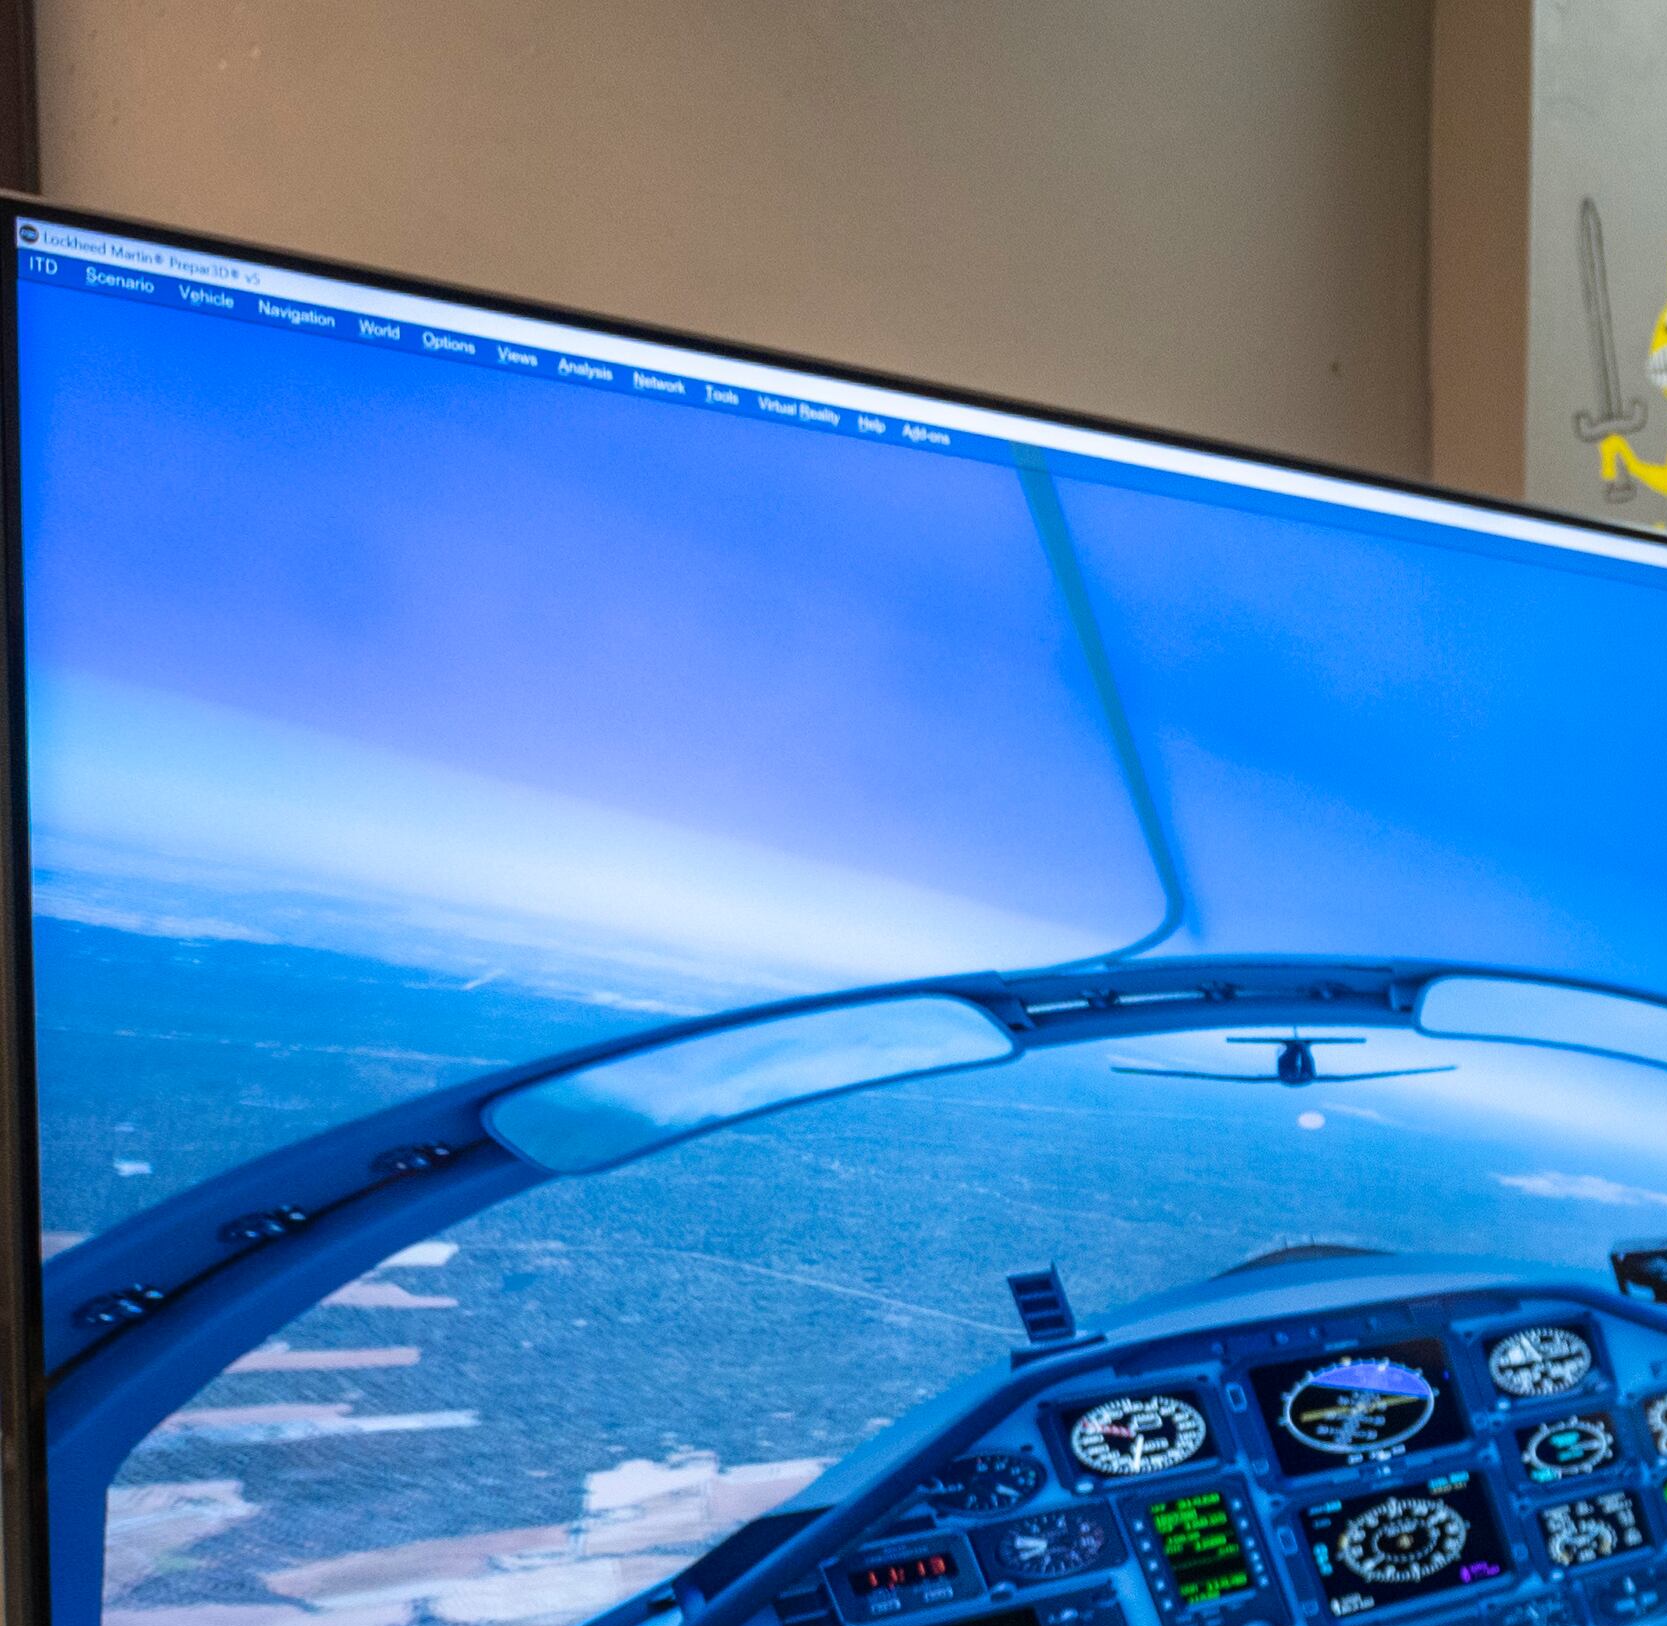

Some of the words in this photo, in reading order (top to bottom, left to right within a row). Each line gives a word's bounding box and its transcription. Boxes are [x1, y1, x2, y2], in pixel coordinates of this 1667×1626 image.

[43, 230, 106, 255] Lockheed
[29, 255, 58, 275] ITD
[85, 266, 154, 294] Scenario
[178, 284, 234, 308] Vehicle
[258, 299, 335, 330] Navigation
[358, 317, 401, 341] World
[422, 331, 476, 356] Options
[497, 345, 538, 368] Views
[558, 356, 613, 383] Analysis
[632, 371, 686, 395] Network
[705, 384, 740, 407] Tools
[758, 395, 797, 418] Virtual
[799, 402, 841, 427] Reality
[858, 415, 886, 435] Help
[902, 424, 950, 446] Add-ons
